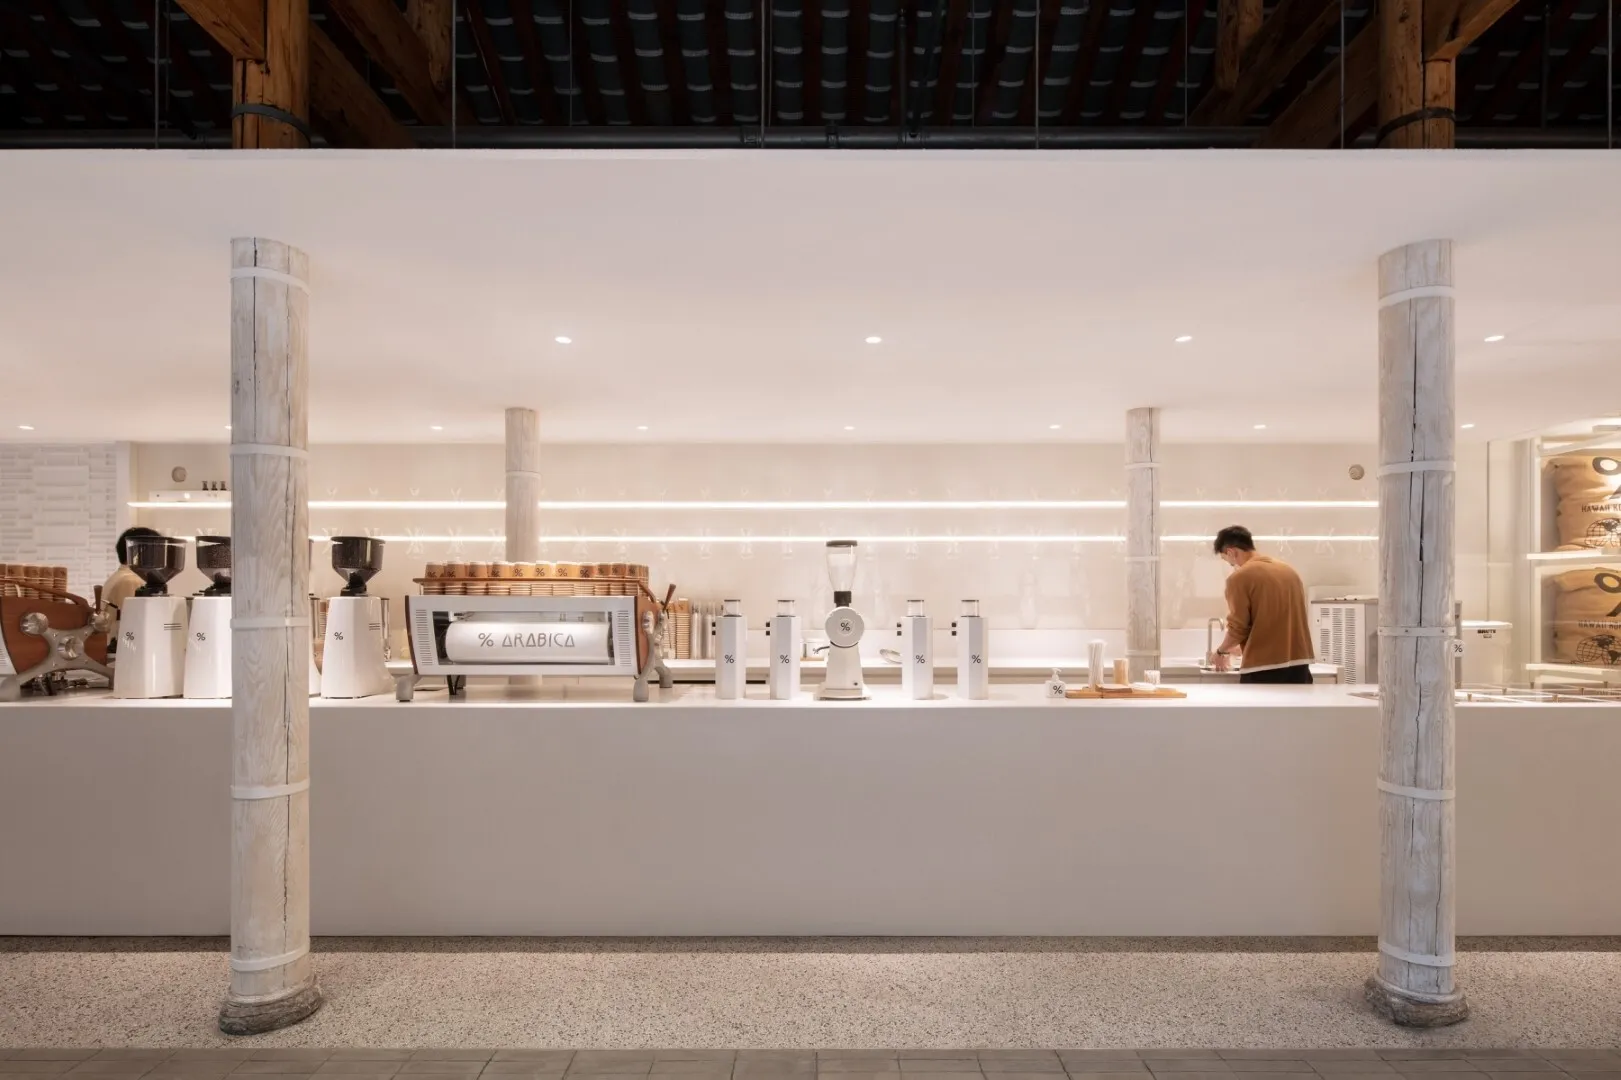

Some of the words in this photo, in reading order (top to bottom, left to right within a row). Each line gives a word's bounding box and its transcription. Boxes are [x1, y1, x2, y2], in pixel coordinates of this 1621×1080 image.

[1581, 503, 1610, 513] HAWAII
[478, 633, 494, 647] %
[502, 633, 575, 648] ARABICA
